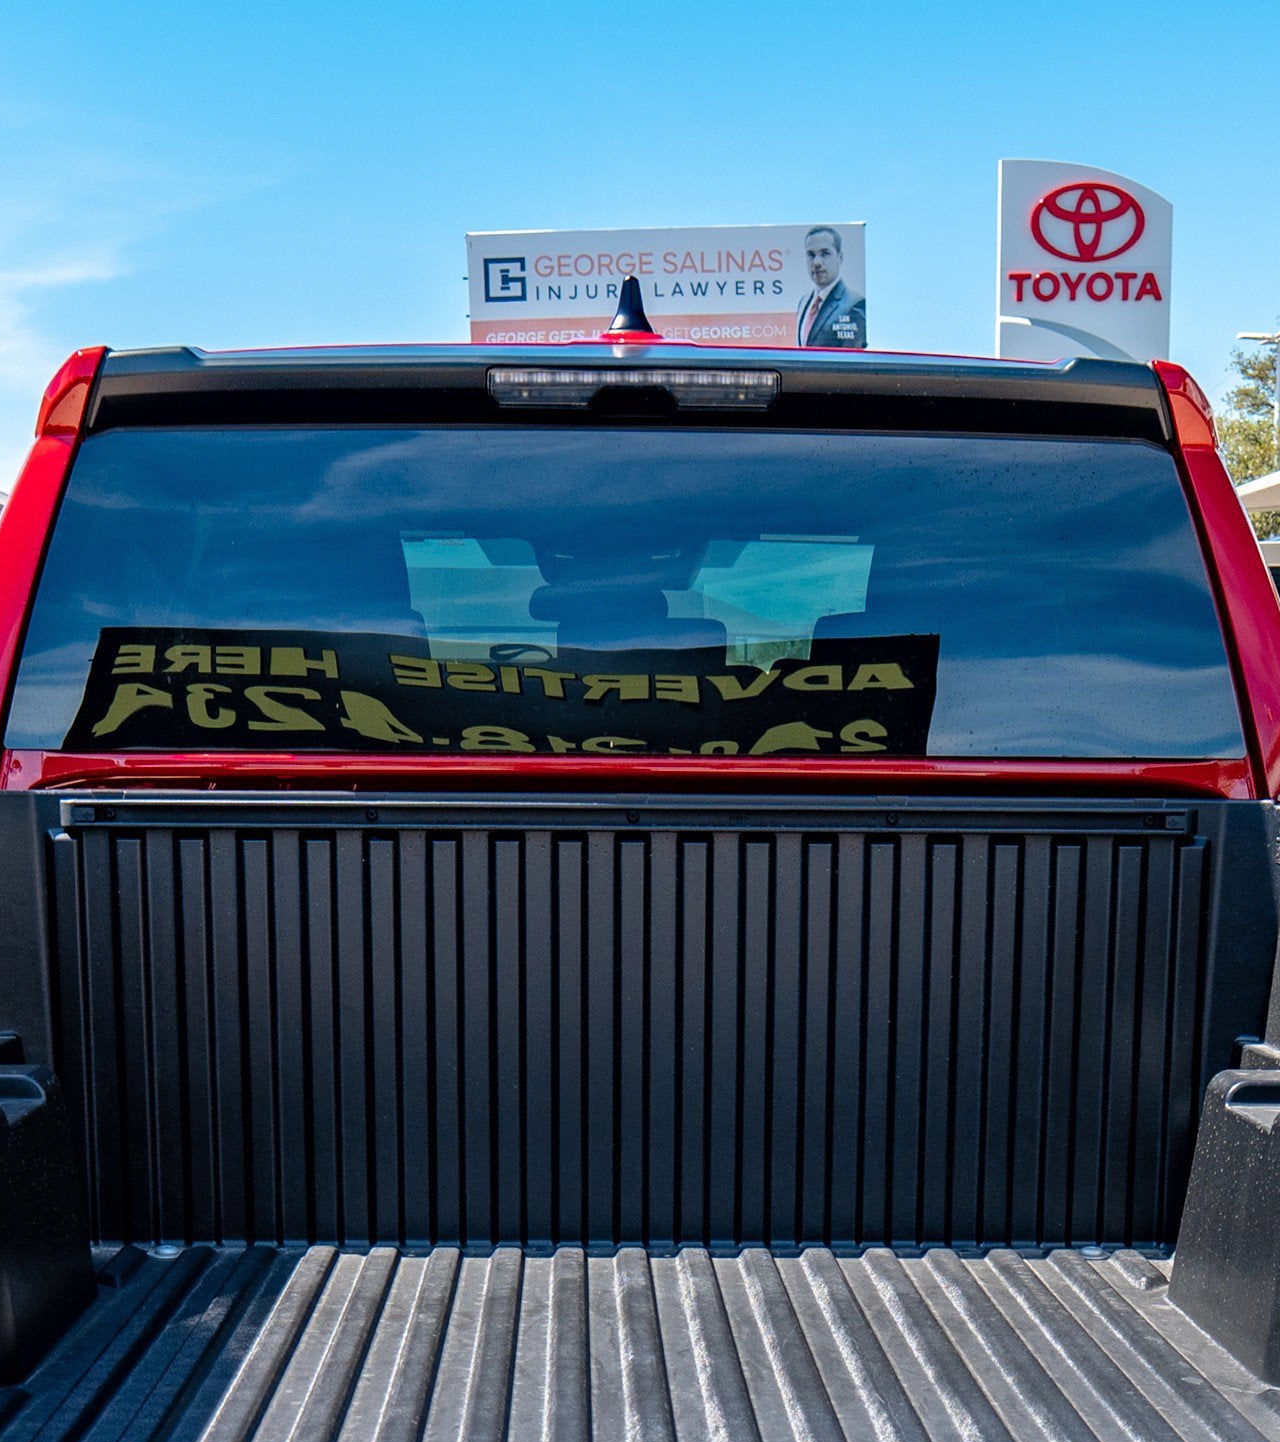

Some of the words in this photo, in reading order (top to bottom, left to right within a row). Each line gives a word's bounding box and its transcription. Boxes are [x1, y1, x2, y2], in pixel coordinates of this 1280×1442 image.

[534, 253, 654, 277] GEORGE
[663, 249, 784, 274] SALINAS
[536, 283, 618, 301] INJUR
[654, 279, 783, 298] LAWYERS
[1009, 271, 1162, 302] TOYOTA
[485, 330, 546, 343] GEORGE
